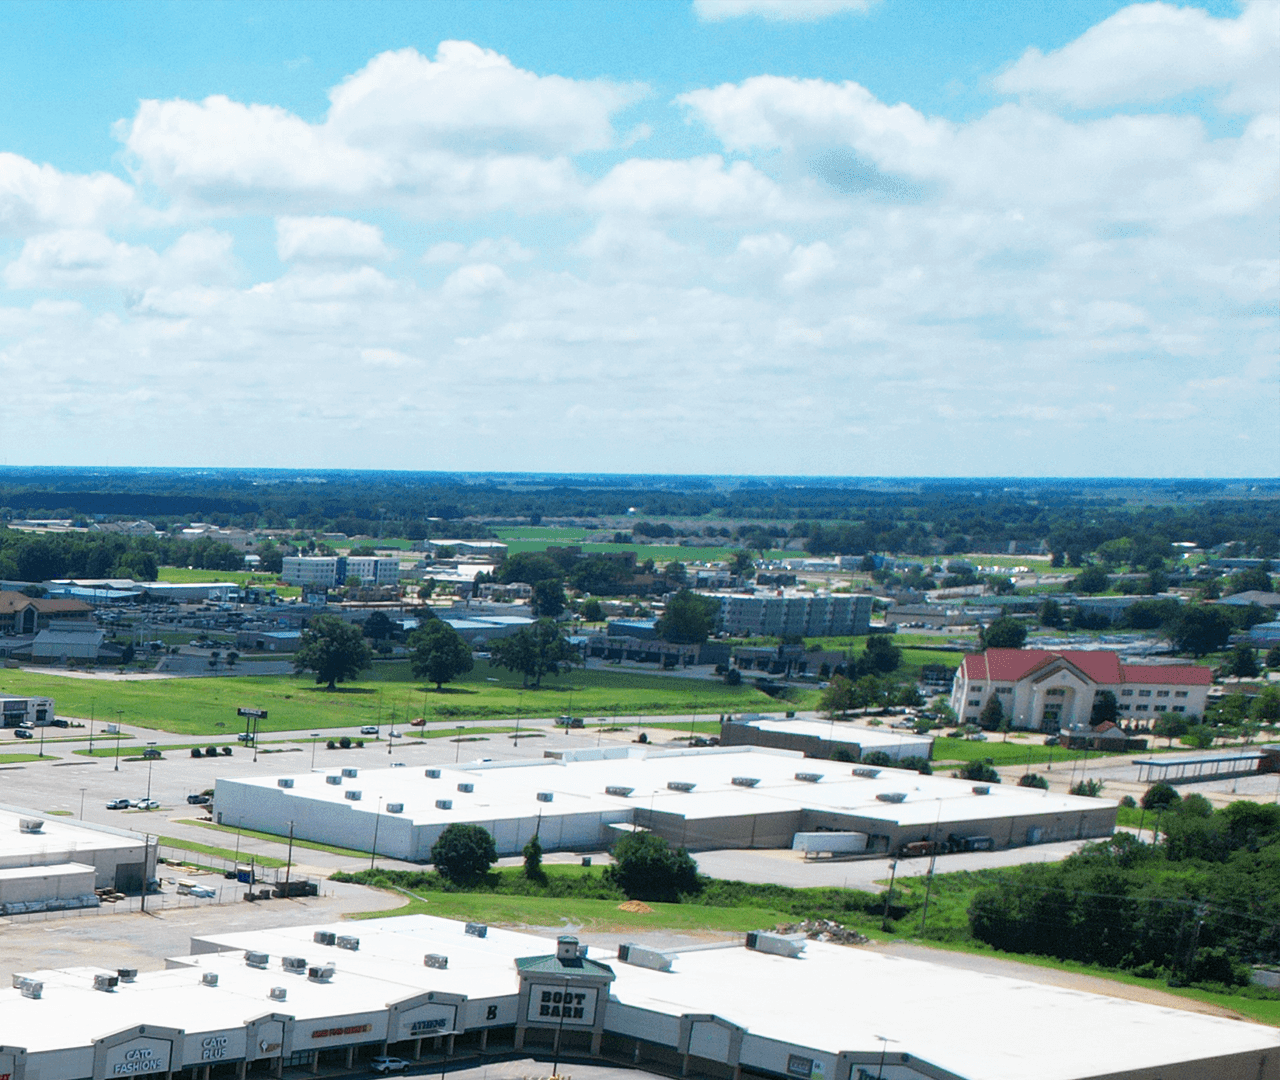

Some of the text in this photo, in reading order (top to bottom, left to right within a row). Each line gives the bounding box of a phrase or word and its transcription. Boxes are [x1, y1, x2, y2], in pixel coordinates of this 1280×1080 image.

[541, 990, 586, 1005] BOOT
[539, 1004, 584, 1019] BARN
[202, 1036, 228, 1049] CATO
[125, 1049, 153, 1061] CATO
[202, 1047, 227, 1060] PLUS
[114, 1059, 162, 1074] FASHIONS
